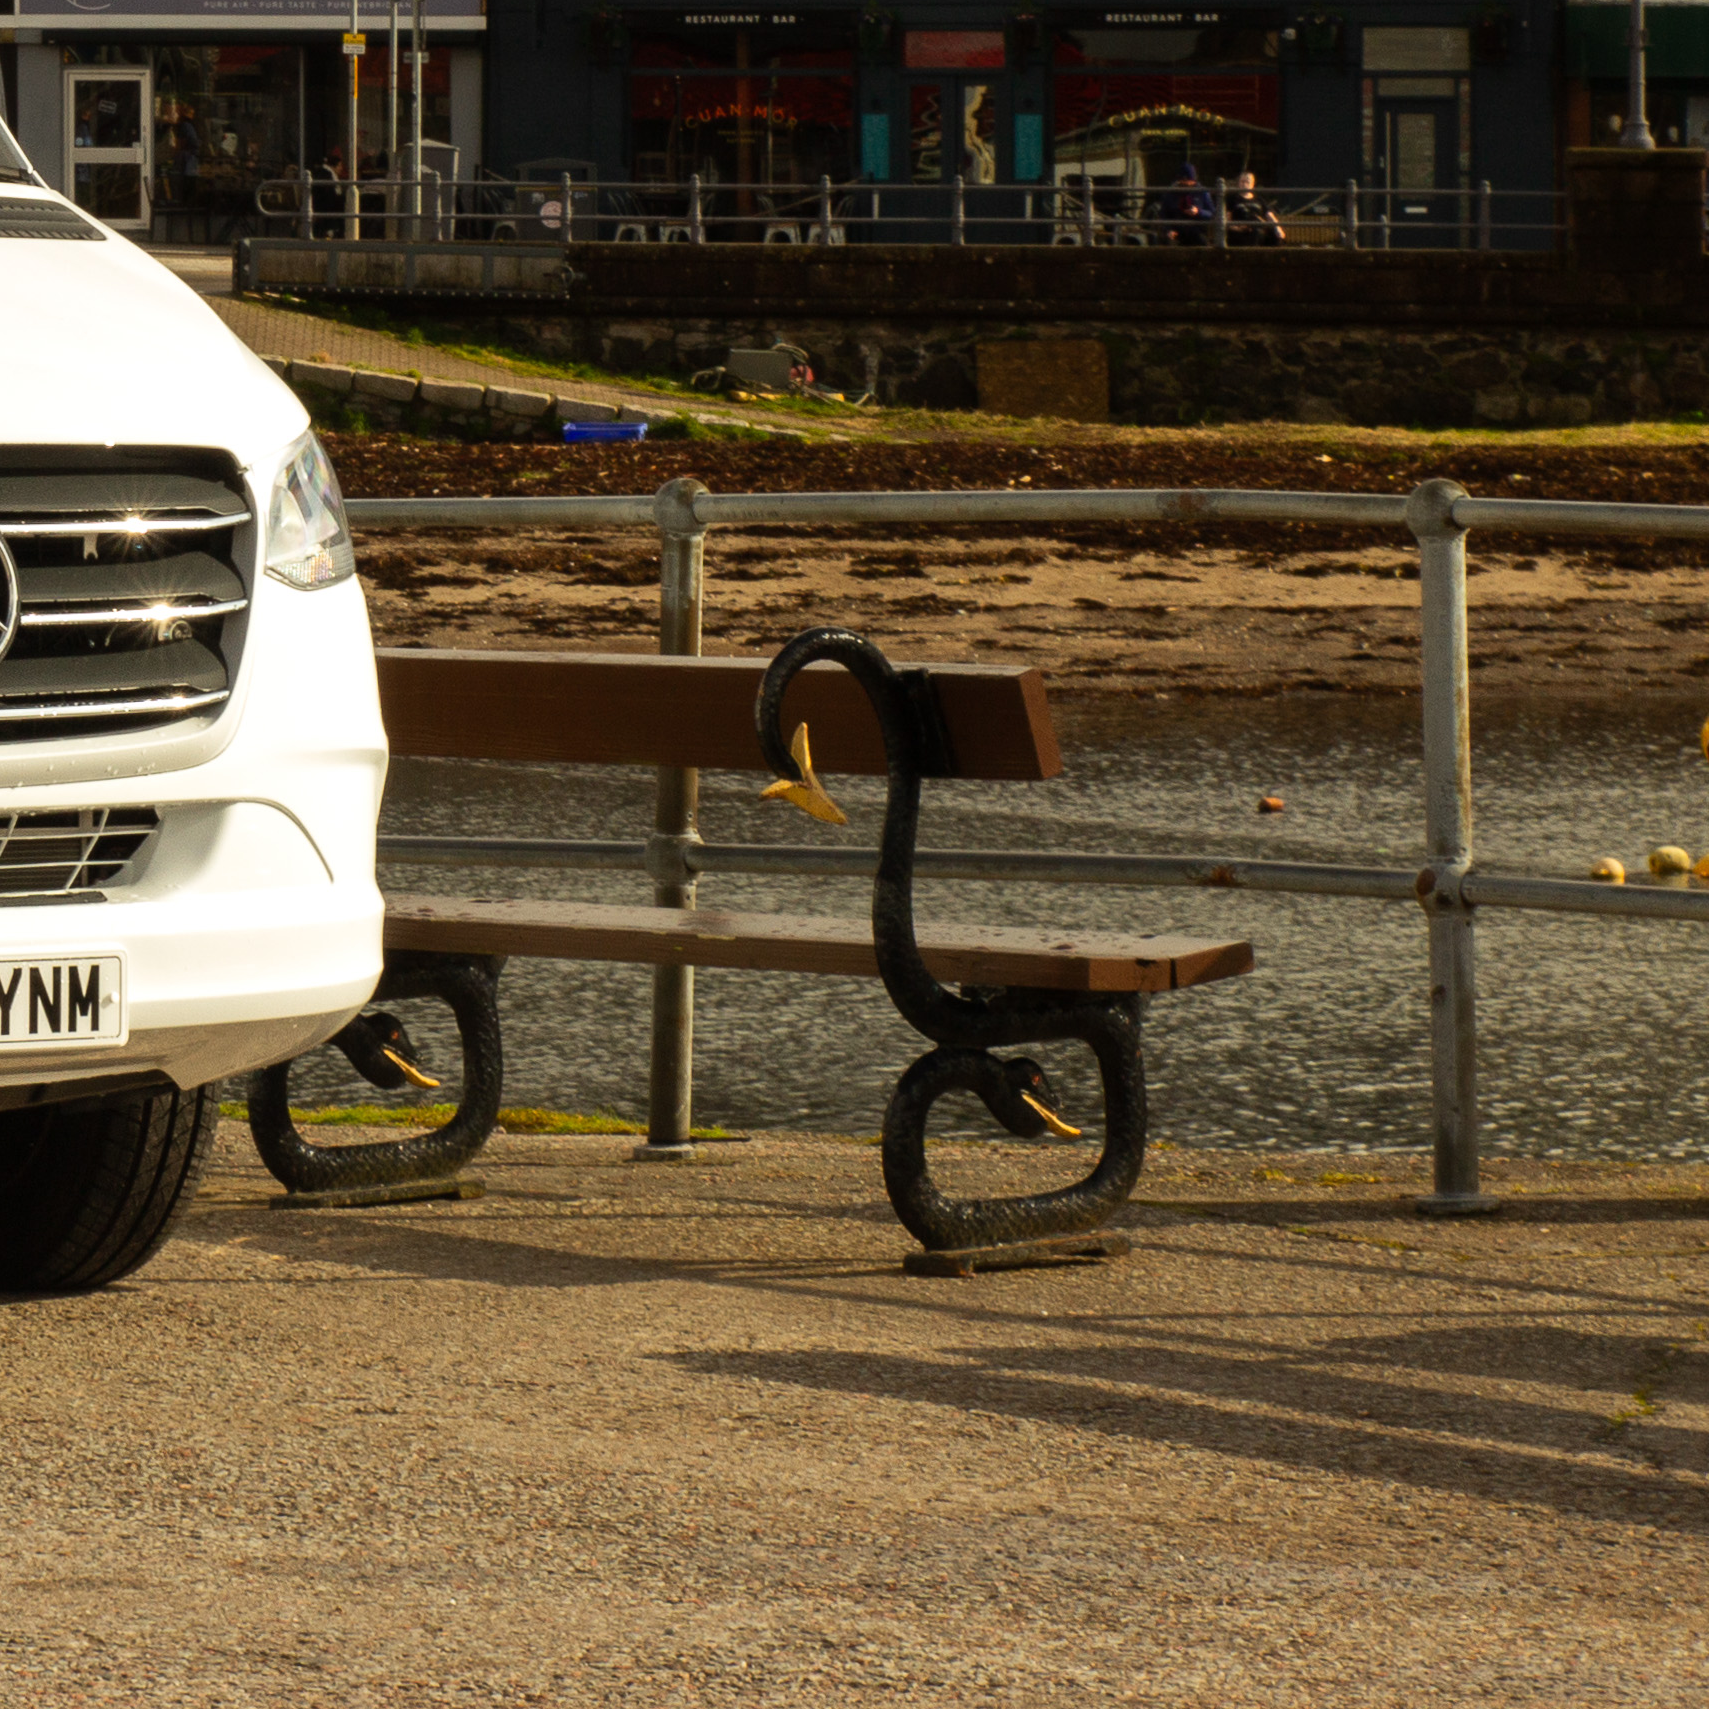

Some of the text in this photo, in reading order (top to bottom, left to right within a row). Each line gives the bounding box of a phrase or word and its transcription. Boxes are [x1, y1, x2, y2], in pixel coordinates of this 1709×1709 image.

[685, 14, 797, 25] RESTAURANT BAR
[1105, 13, 1219, 24] RESTAURANT BAR
